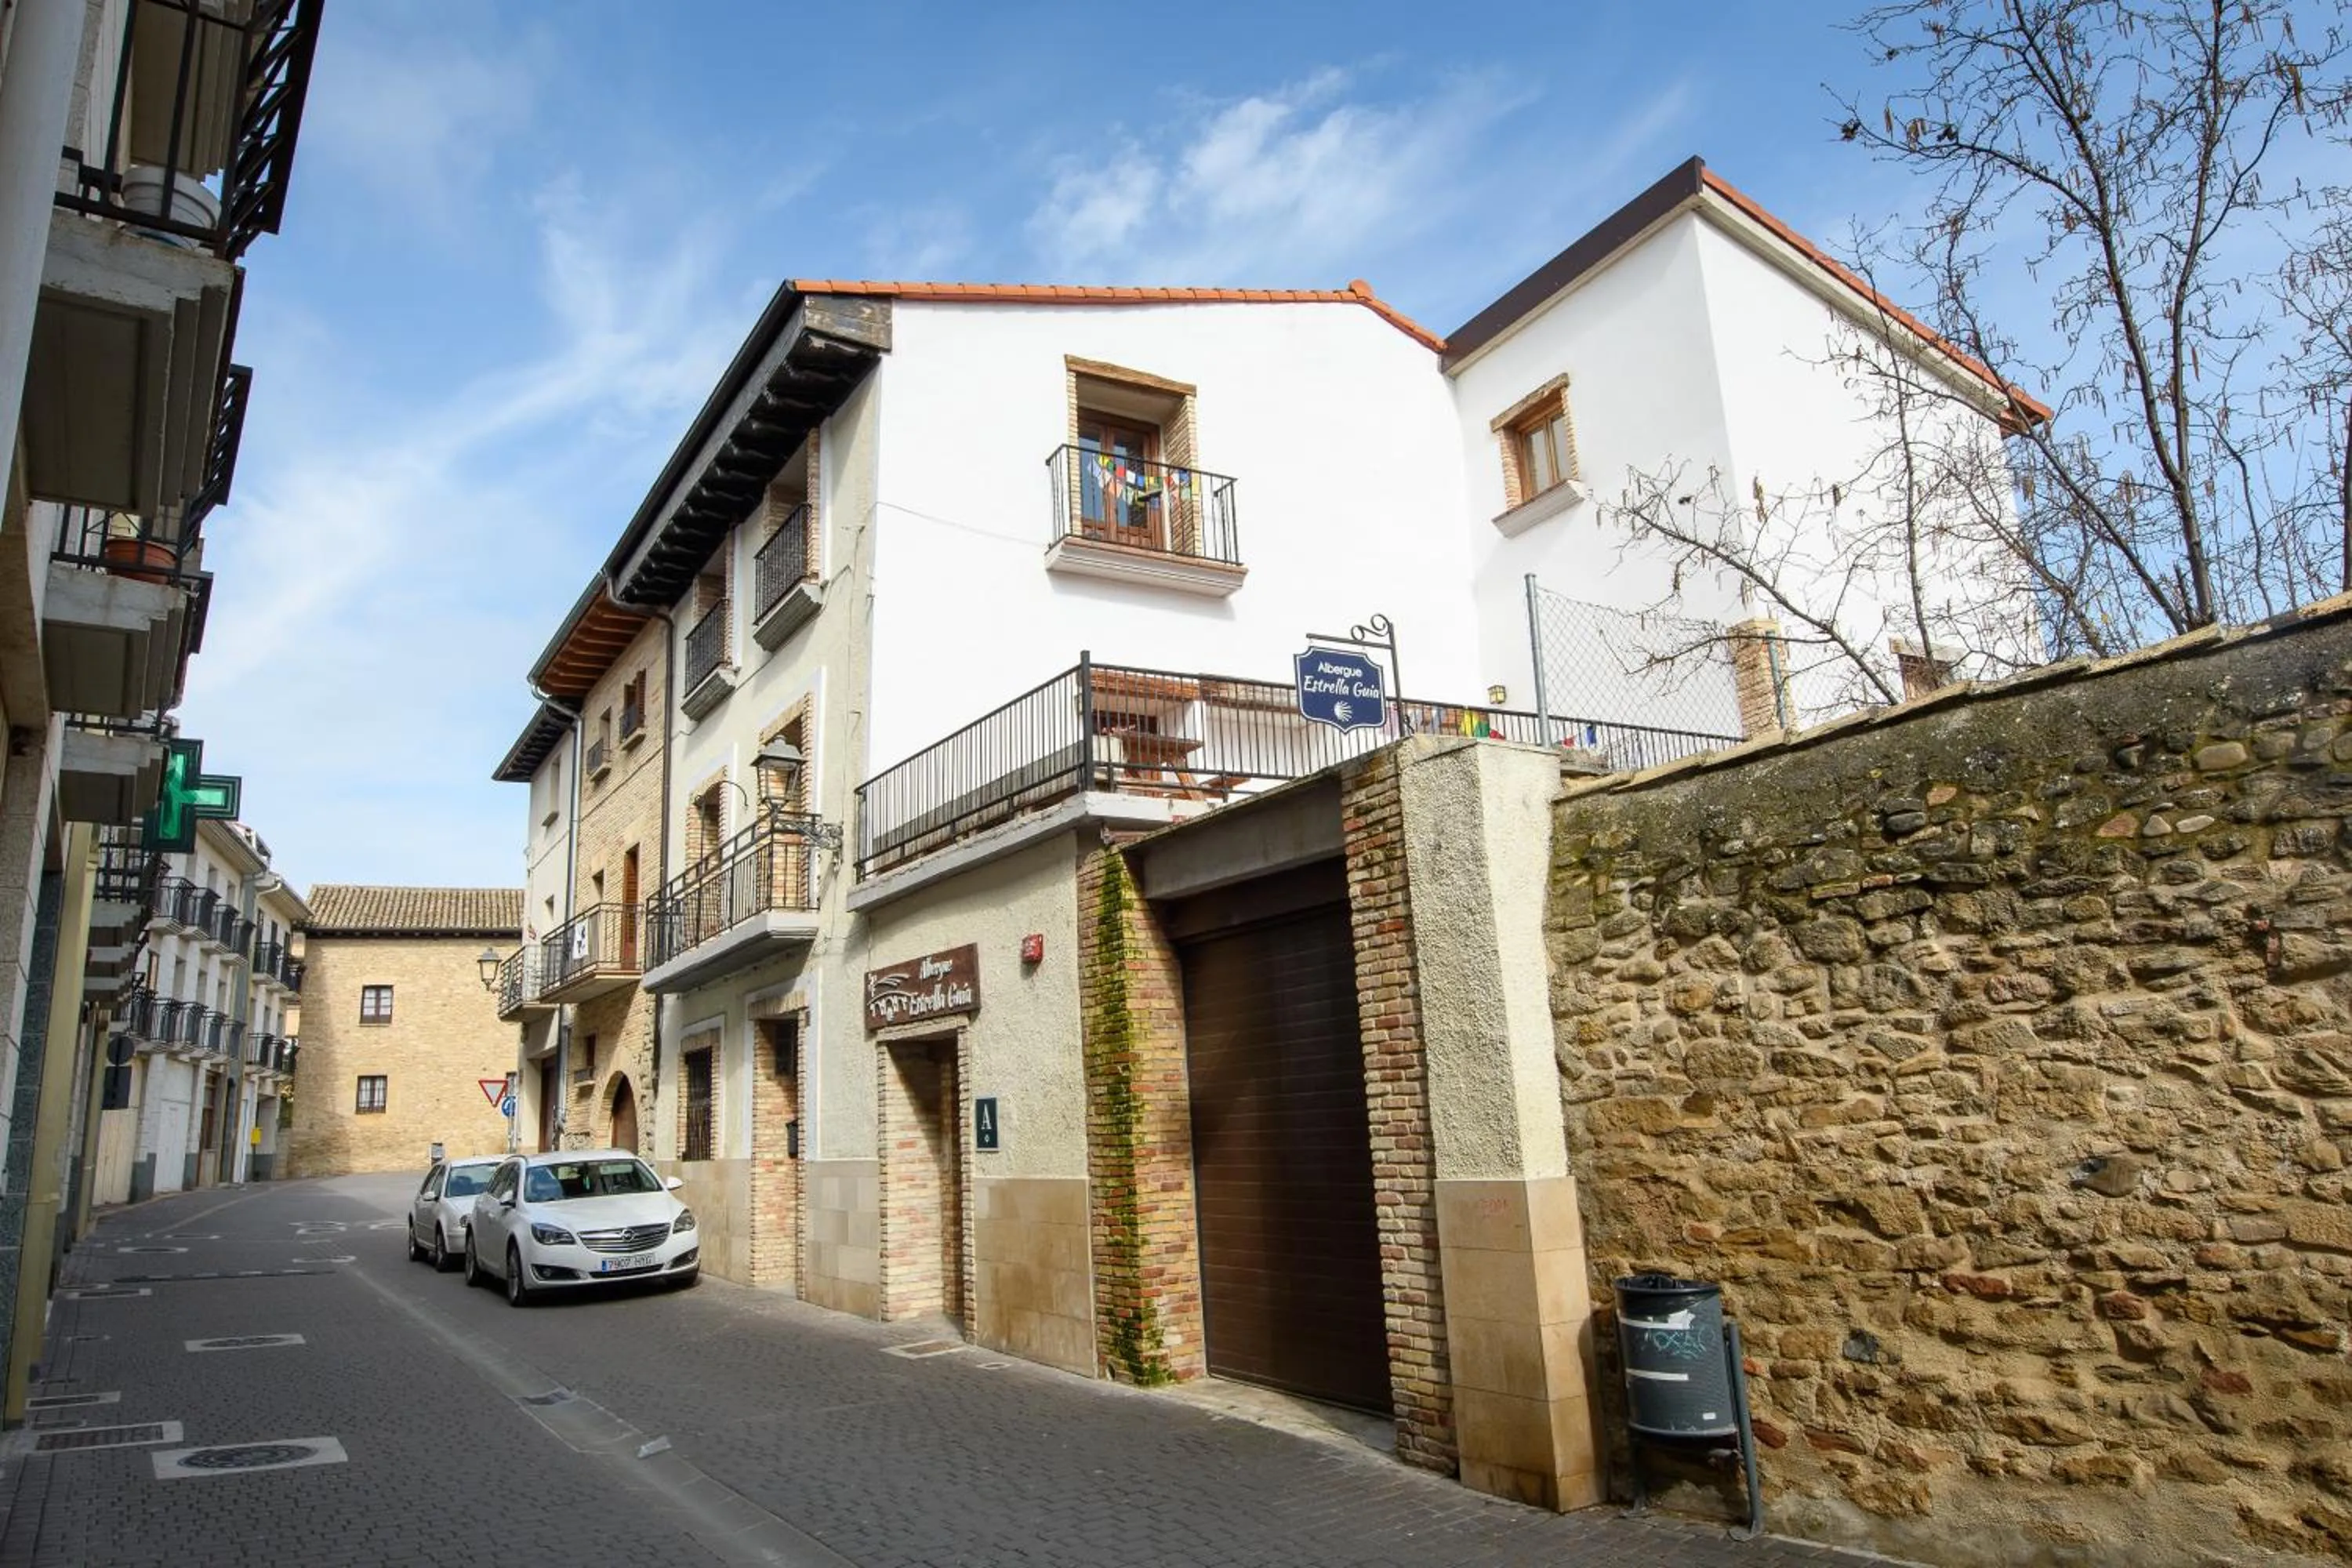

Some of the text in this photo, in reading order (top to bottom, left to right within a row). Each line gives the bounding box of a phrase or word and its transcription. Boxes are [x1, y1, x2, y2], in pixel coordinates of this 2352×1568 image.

[1317, 661, 1363, 678] Albergue
[1303, 675, 1349, 696] Estrella
[981, 1103, 993, 1130] A
